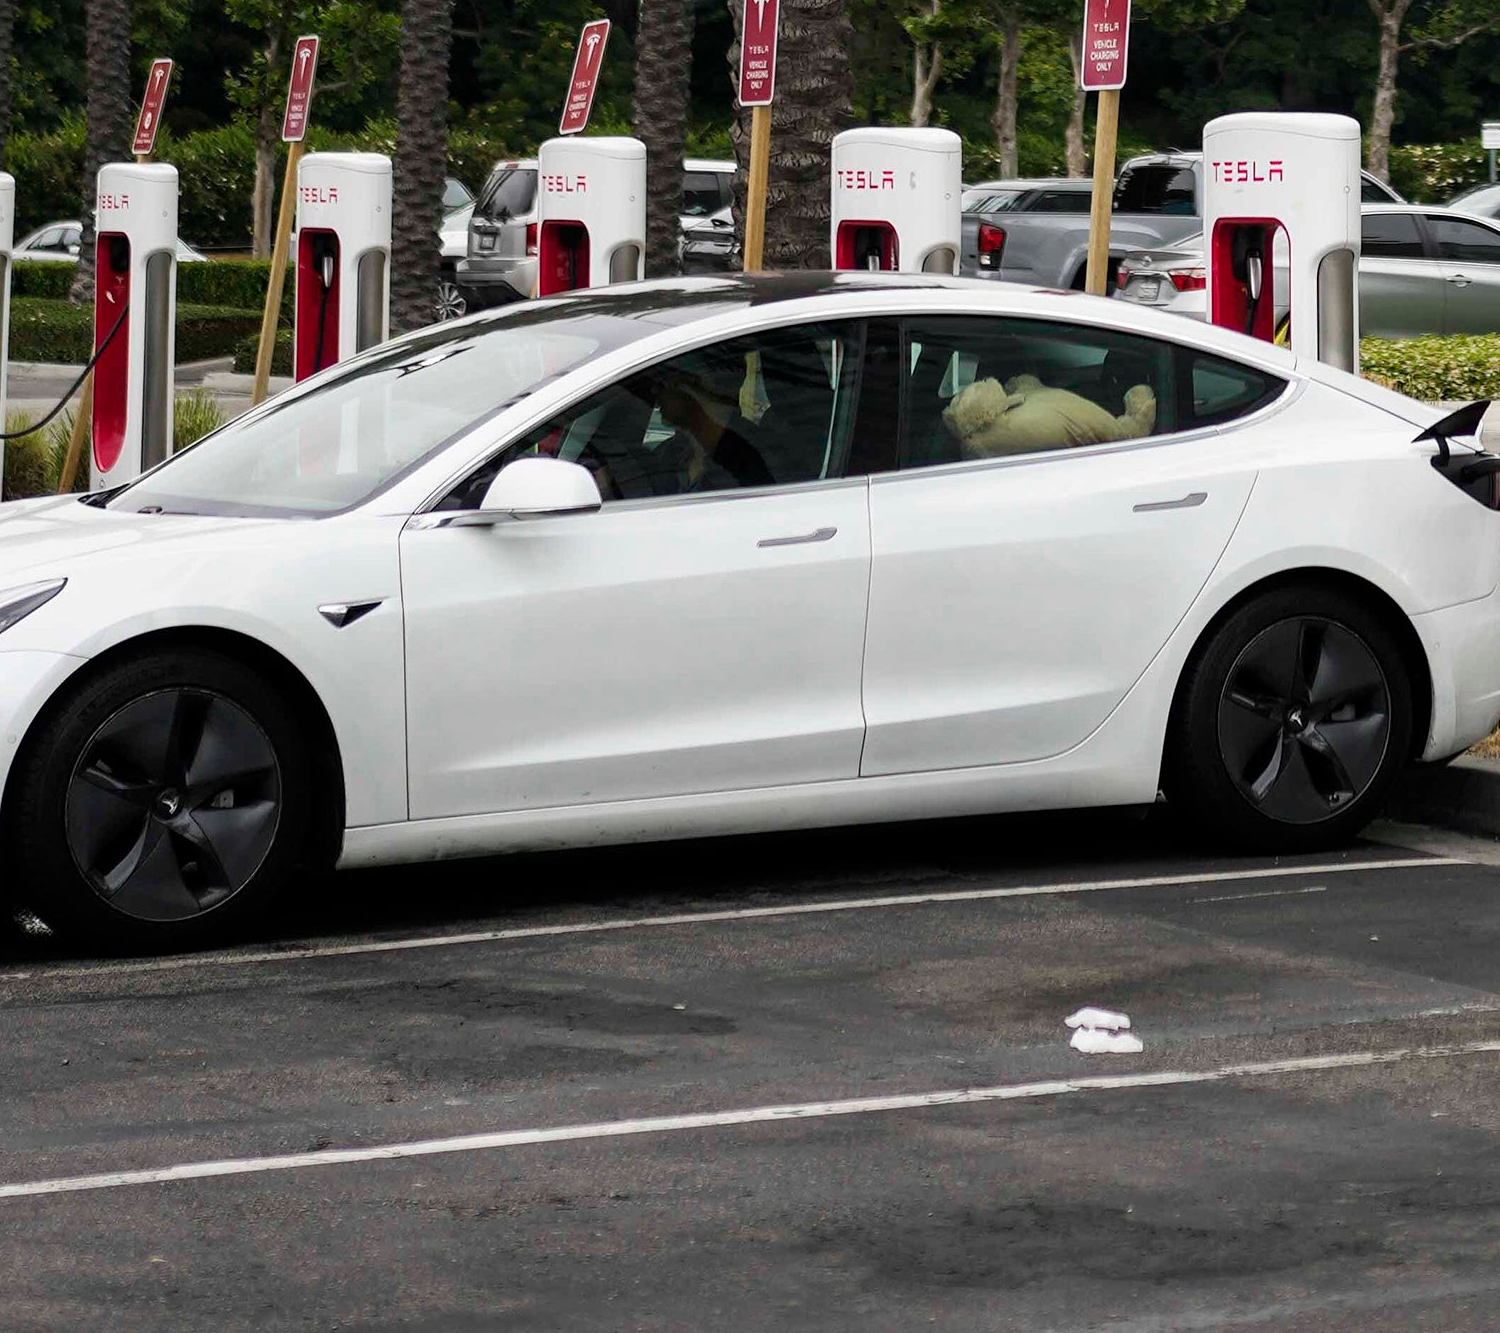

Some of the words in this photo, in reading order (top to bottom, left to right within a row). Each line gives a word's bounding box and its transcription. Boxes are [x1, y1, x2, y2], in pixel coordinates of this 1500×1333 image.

[1093, 22, 1120, 32] TESLA
[838, 171, 894, 189] TESLA
[1213, 161, 1283, 182] TESLA
